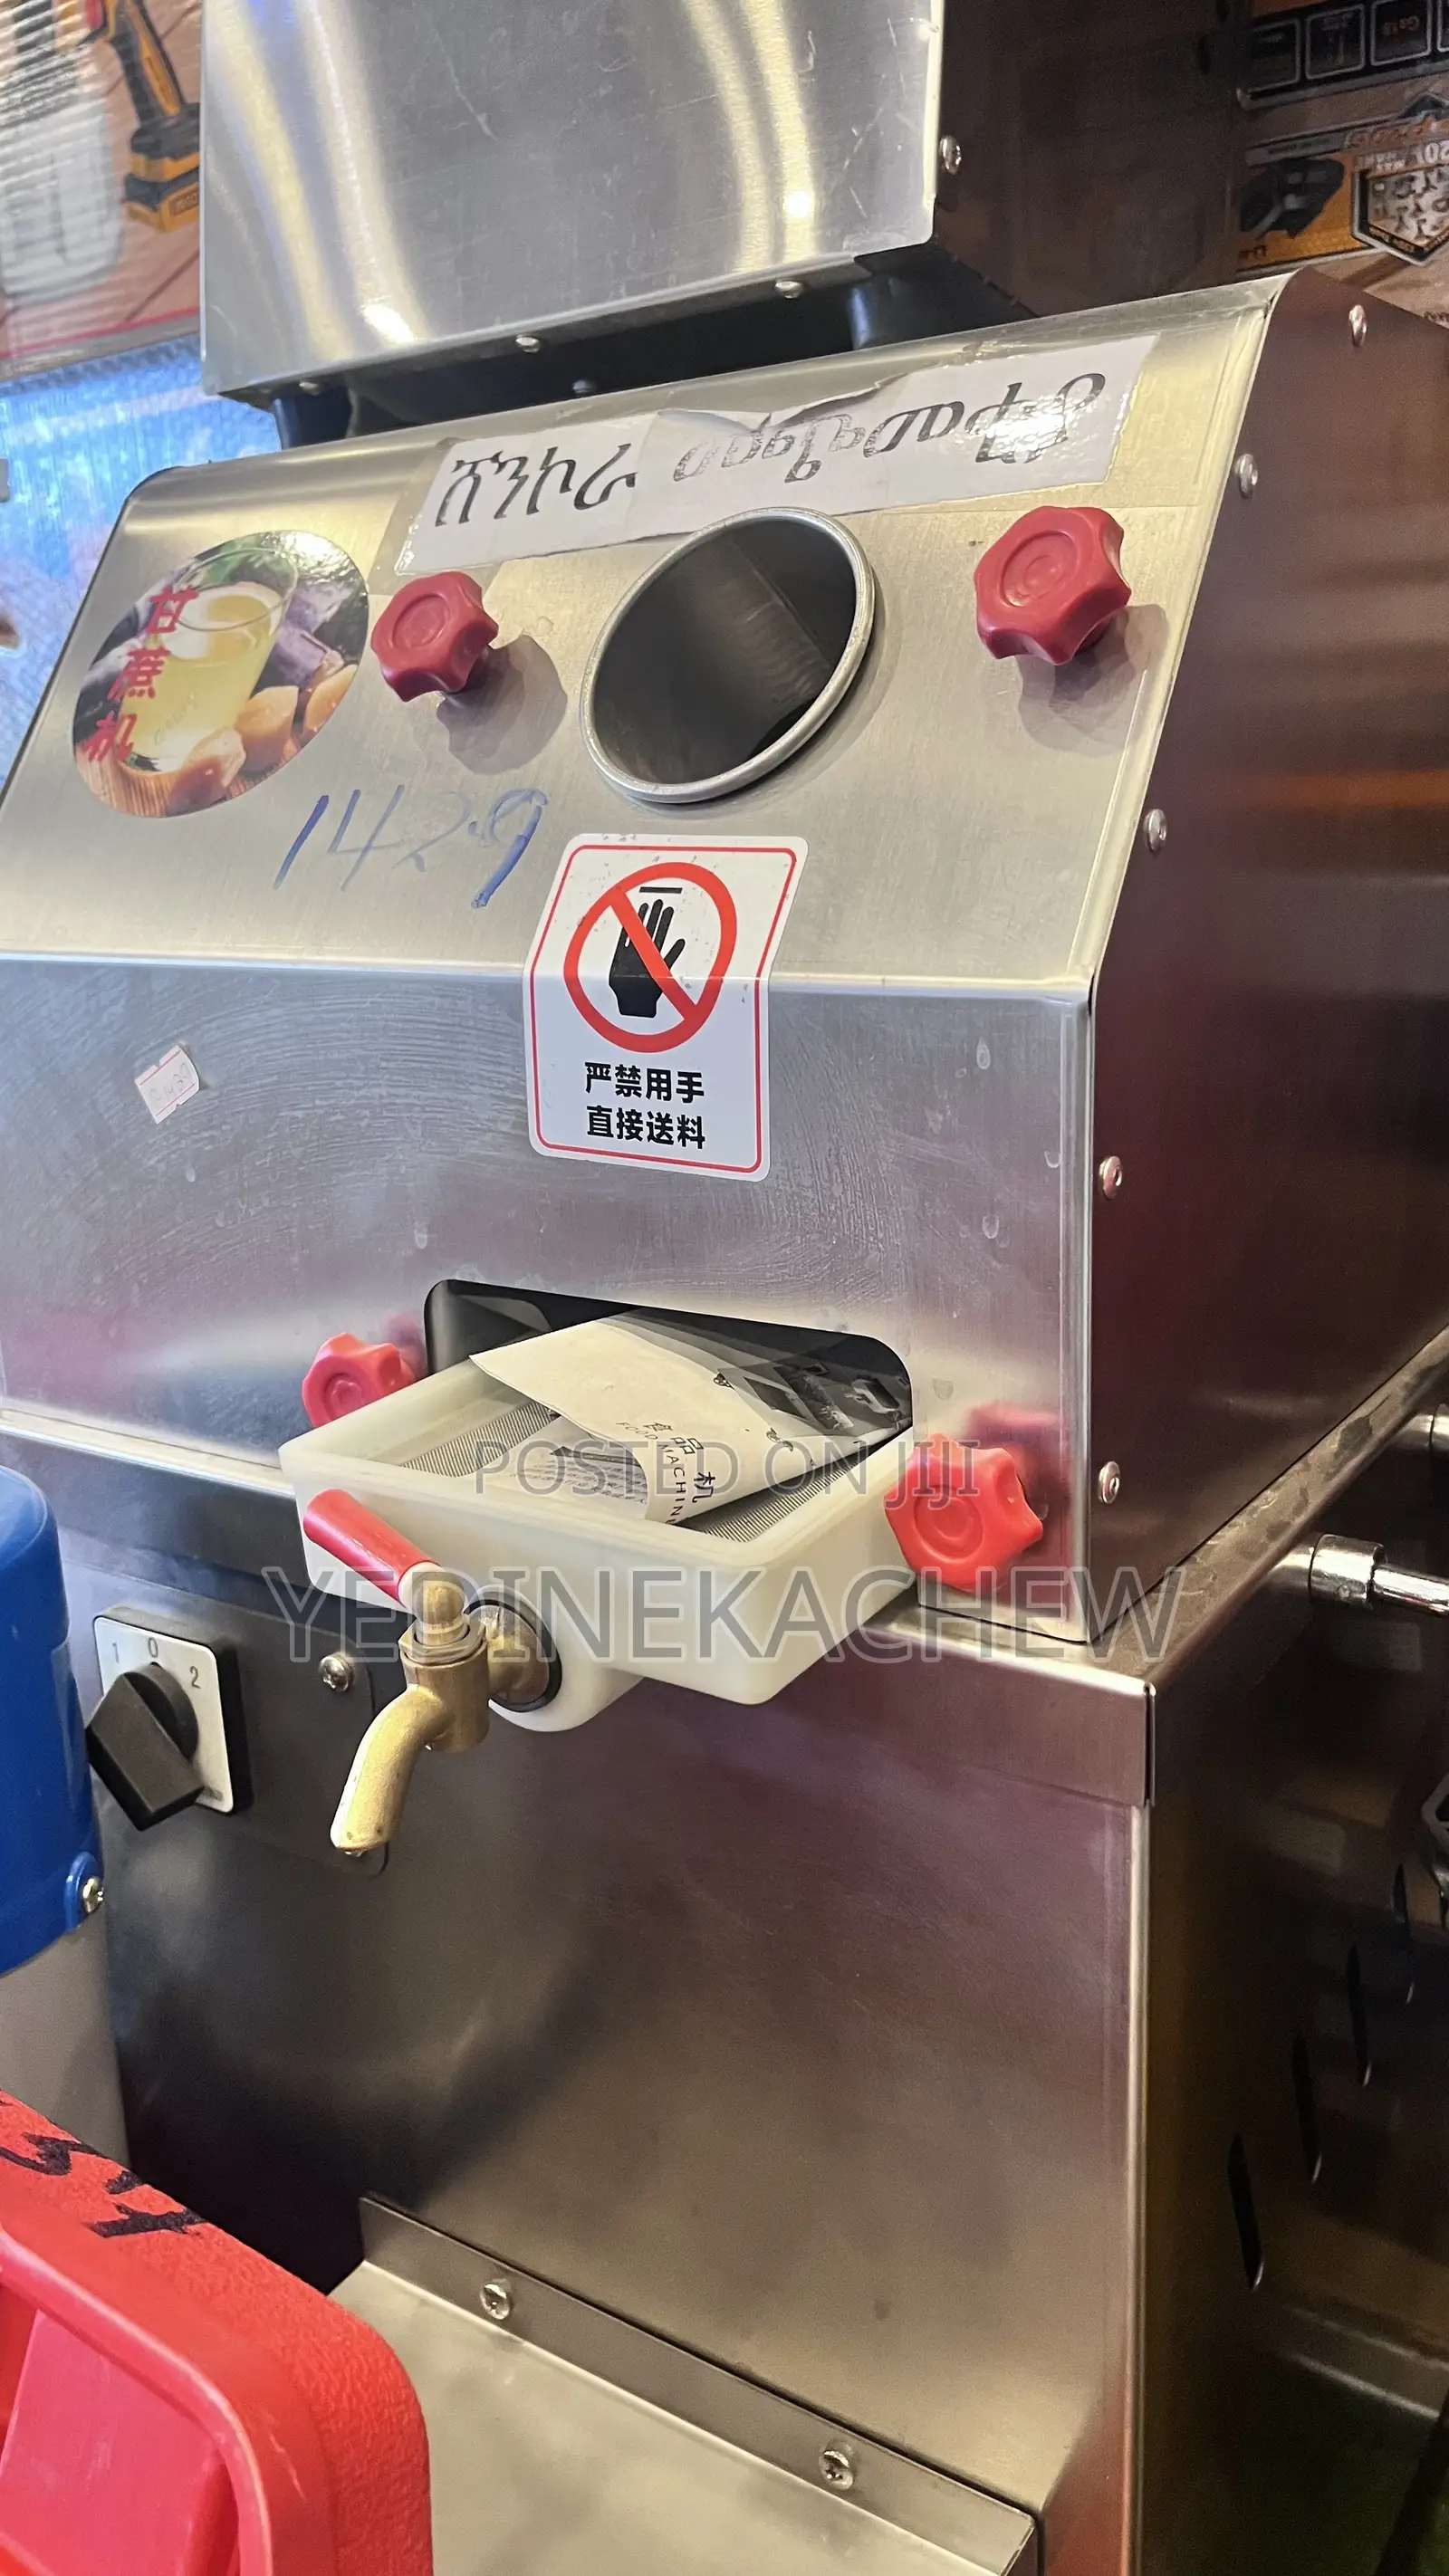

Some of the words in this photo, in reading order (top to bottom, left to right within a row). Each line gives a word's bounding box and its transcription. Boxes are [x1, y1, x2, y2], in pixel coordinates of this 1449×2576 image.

[82, 584, 199, 762] 甘蔗机
[584, 1062, 705, 1103] 严禁用手
[587, 1105, 705, 1150] 直接送料
[615, 1422, 659, 1441] FOOD
[111, 1642, 120, 1663] 1
[148, 1637, 158, 1658] 0
[189, 1666, 201, 1690] 2
